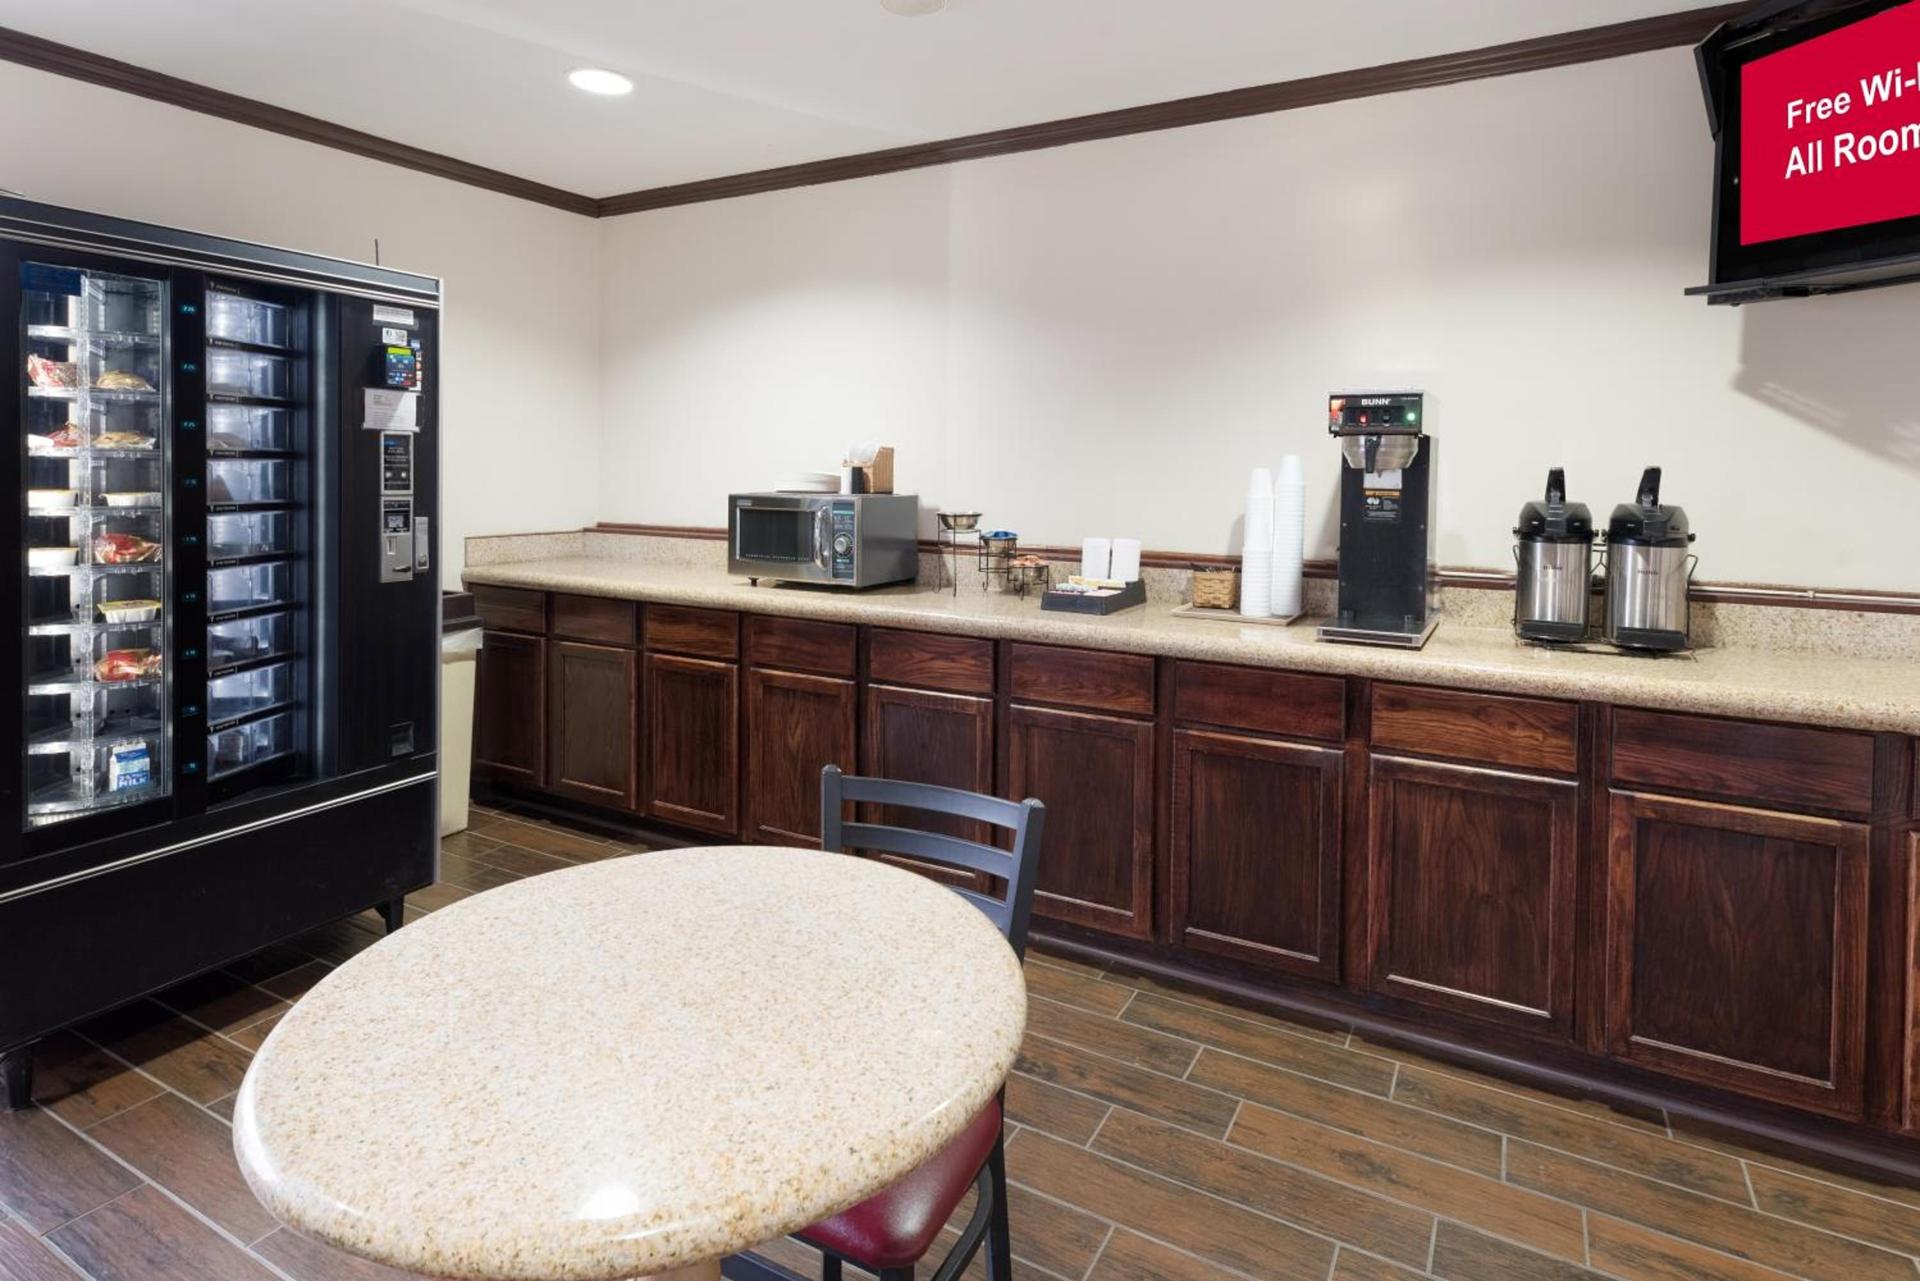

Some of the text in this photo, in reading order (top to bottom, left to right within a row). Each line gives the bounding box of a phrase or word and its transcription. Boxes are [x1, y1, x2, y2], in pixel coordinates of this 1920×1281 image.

[1786, 61, 1920, 130] Free Wi-
[1784, 139, 1823, 180] All
[1361, 398, 1390, 406] BUNN
